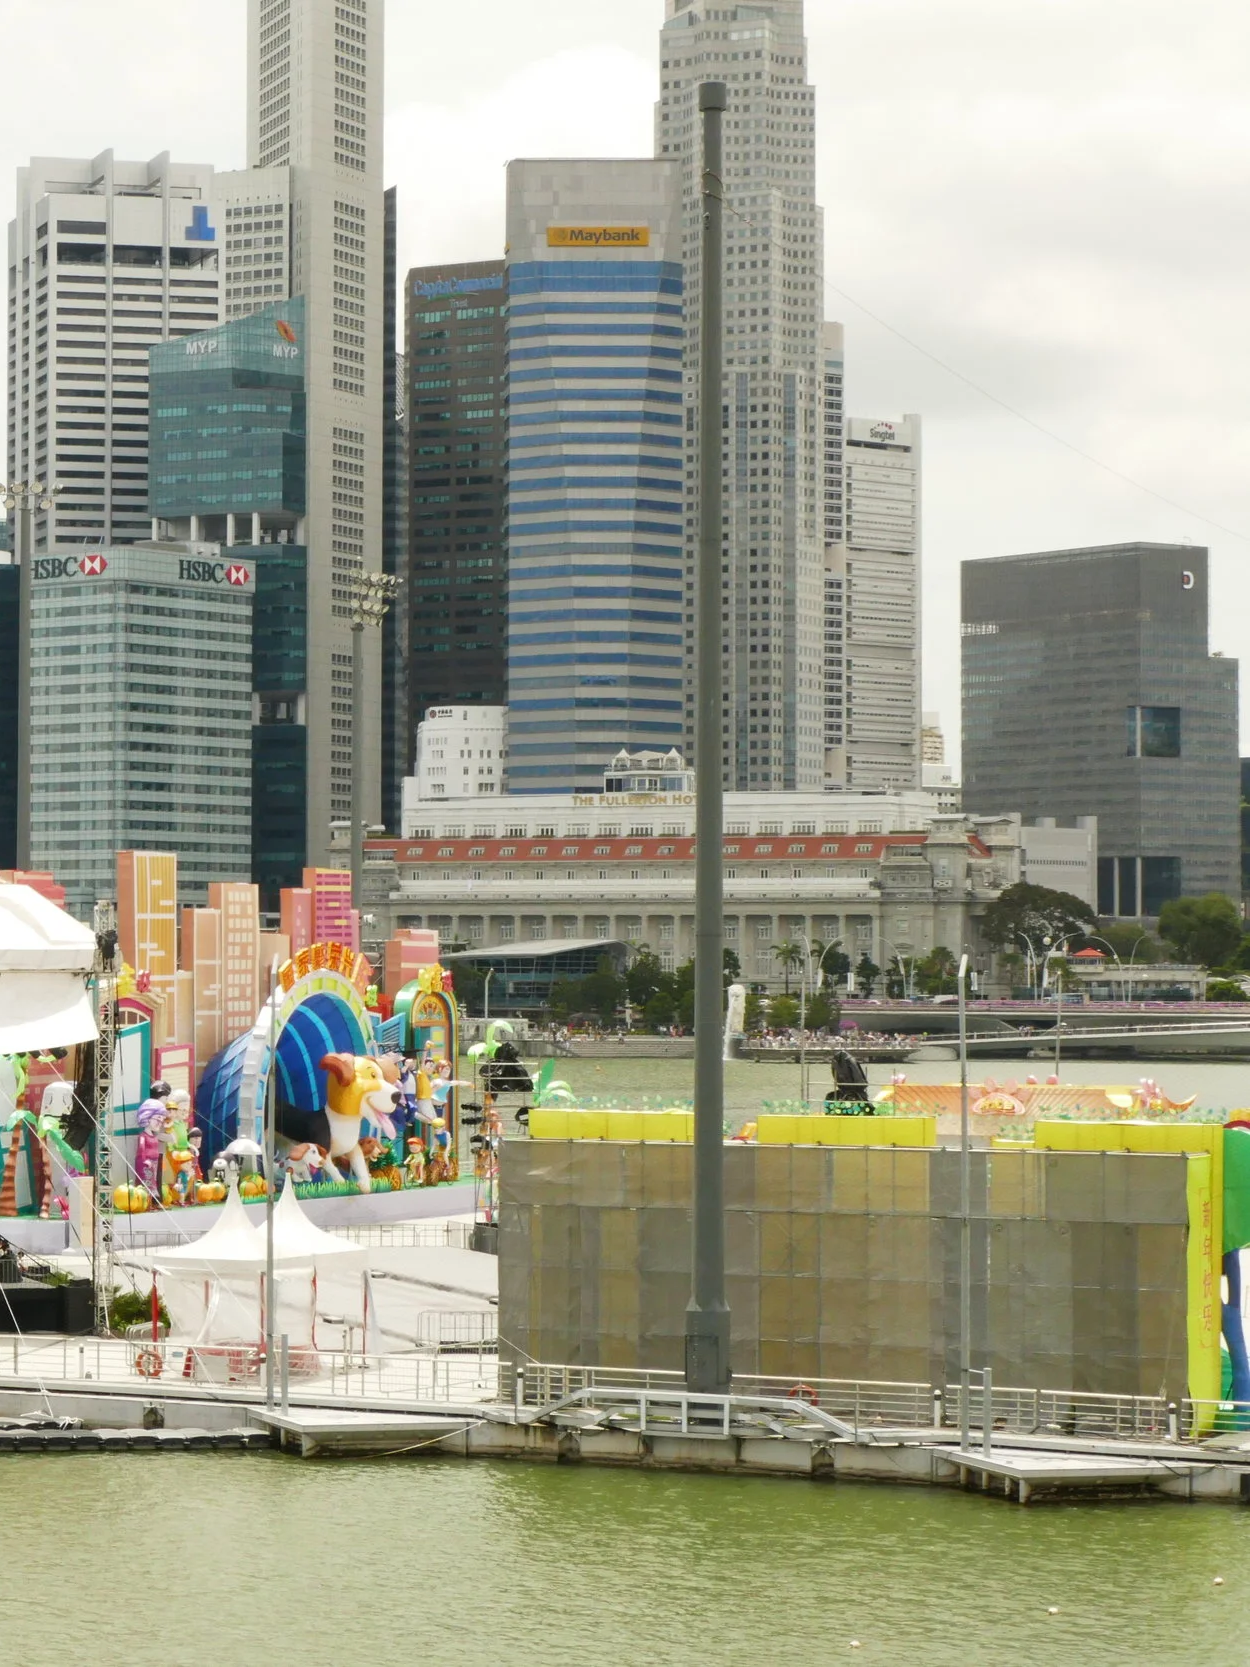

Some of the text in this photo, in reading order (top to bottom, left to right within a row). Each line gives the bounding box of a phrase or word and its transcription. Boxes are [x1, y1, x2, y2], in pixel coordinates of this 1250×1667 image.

[569, 229, 640, 244] Maybank
[186, 341, 218, 355] MYP
[273, 345, 299, 359] MYP
[870, 428, 895, 442] Singtel
[178, 560, 225, 584] HSBC
[572, 795, 595, 806] THE
